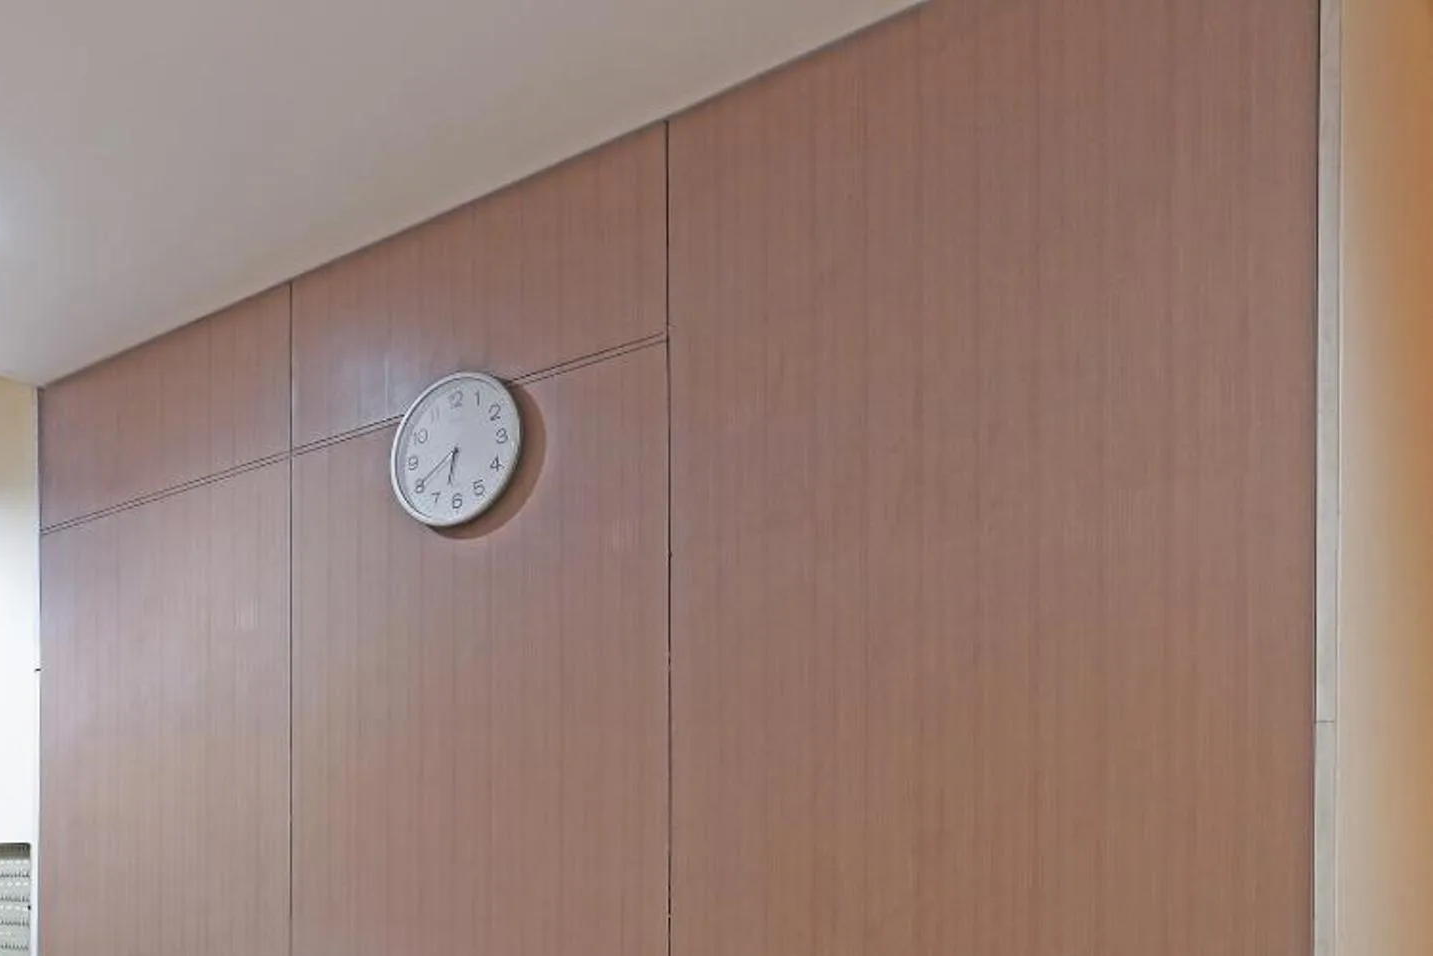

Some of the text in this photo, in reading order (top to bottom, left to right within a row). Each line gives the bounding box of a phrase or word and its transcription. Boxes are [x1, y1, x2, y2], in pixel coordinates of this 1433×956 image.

[488, 402, 501, 421] 2
[496, 428, 508, 444] 3
[489, 456, 503, 472] 4
[472, 479, 485, 496] 5
[431, 492, 441, 504] 7
[452, 493, 463, 509] 6
